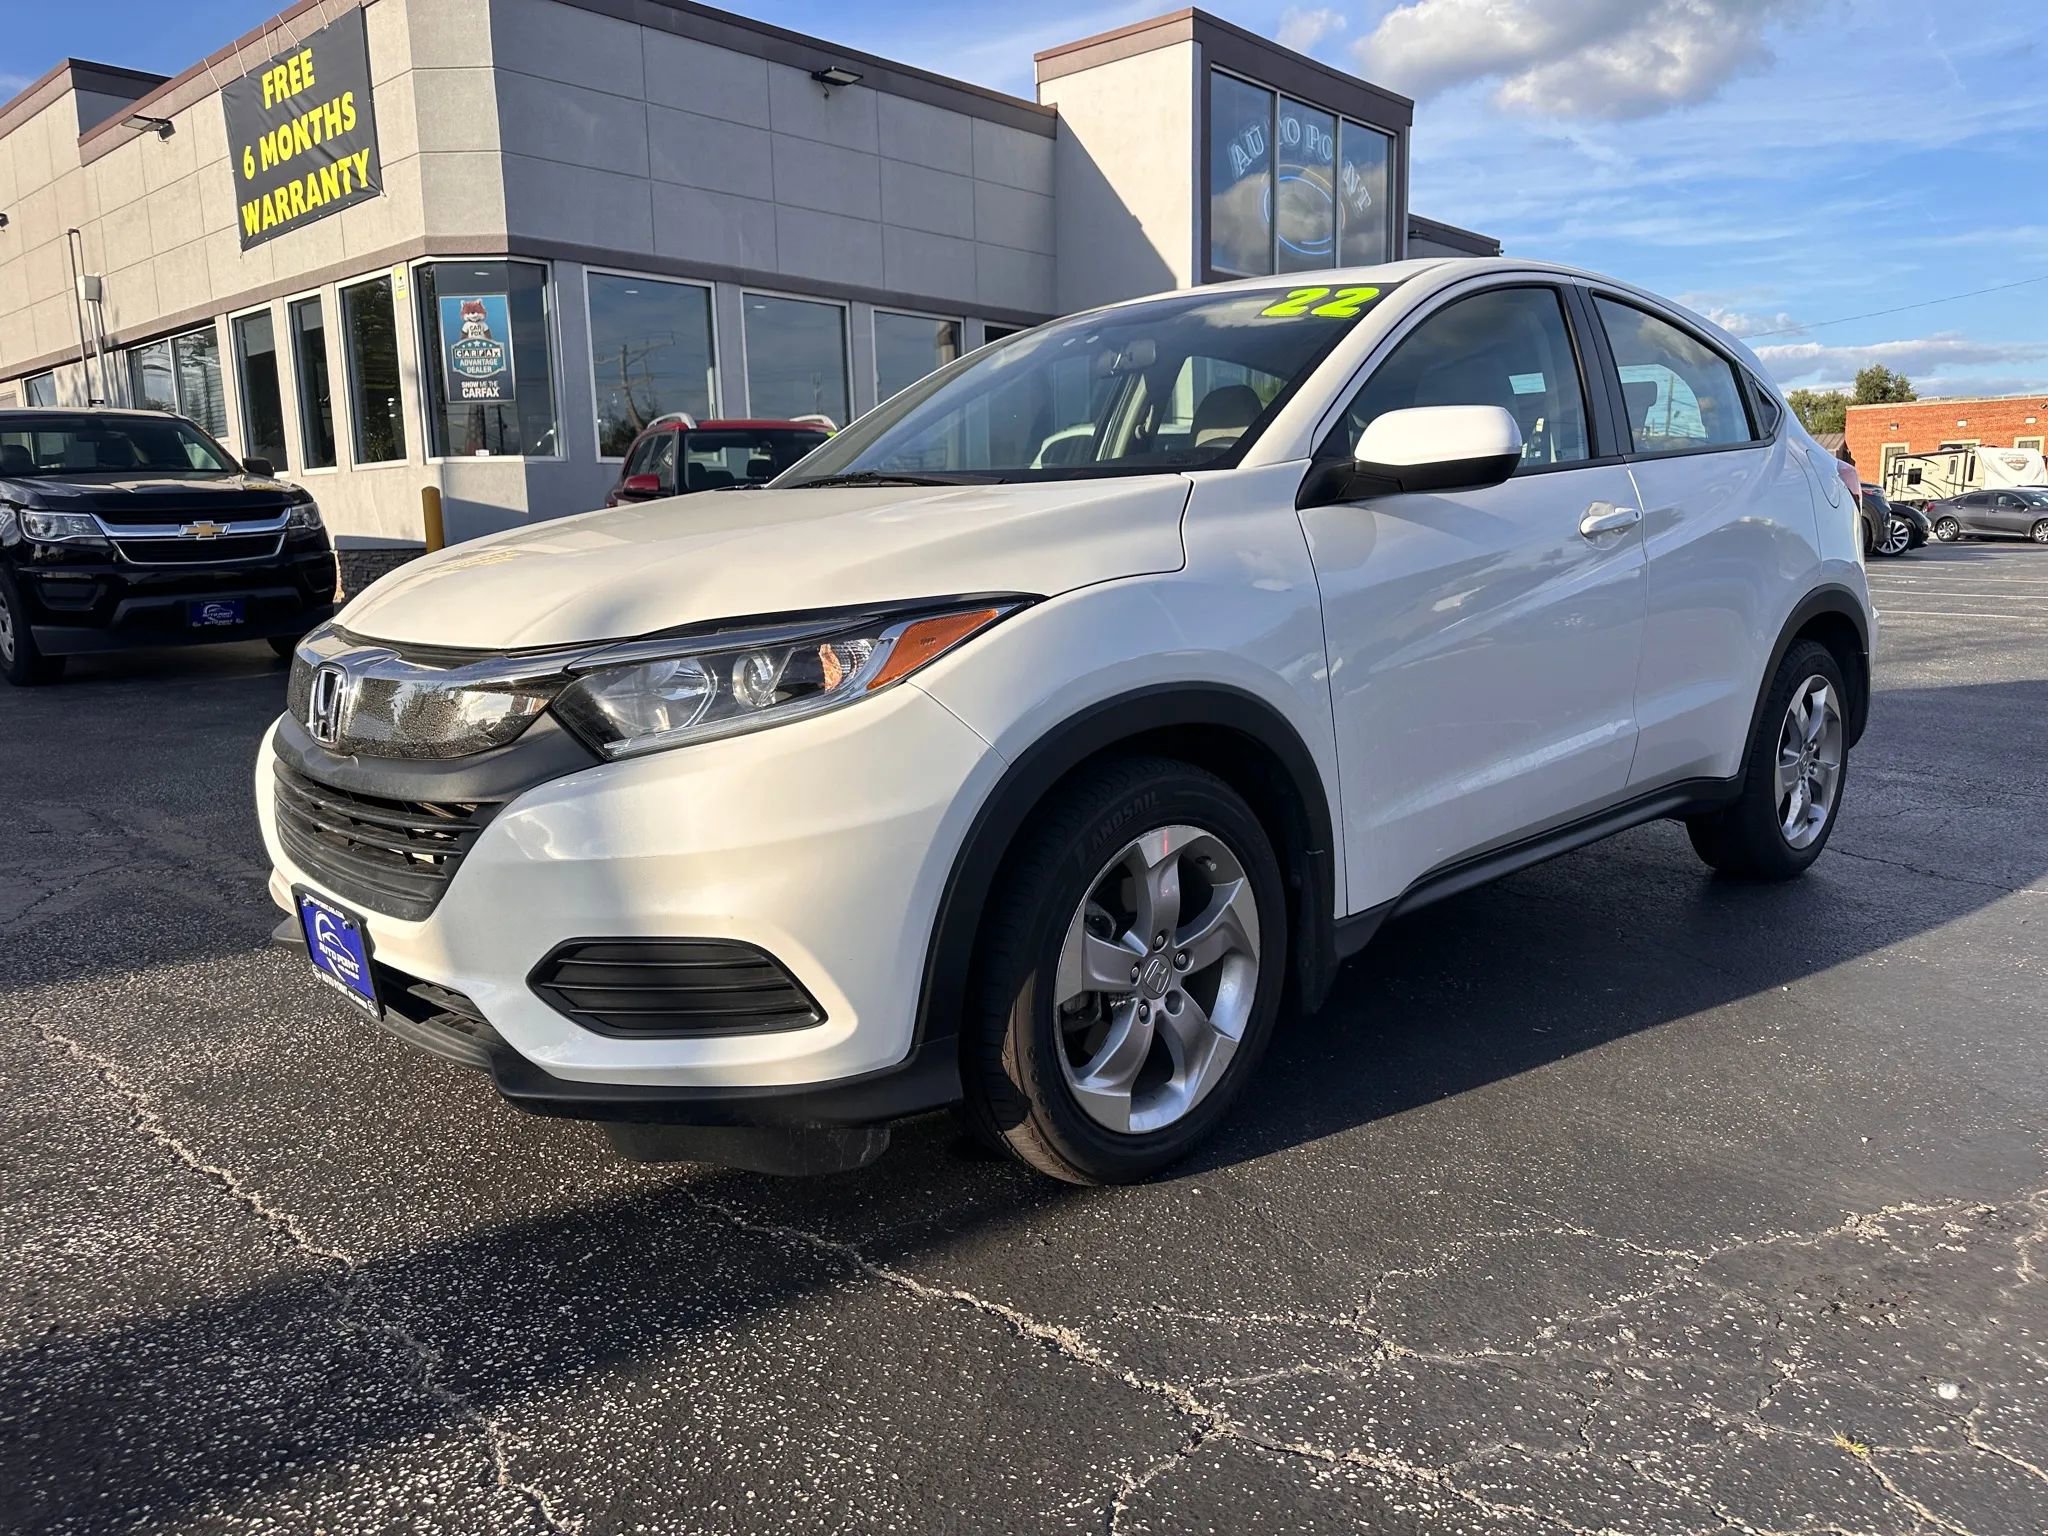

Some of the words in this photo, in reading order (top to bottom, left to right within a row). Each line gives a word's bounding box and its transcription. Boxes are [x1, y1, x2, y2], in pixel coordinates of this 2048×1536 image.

[261, 47, 316, 110] FREE
[243, 145, 256, 181] 6
[259, 91, 357, 172] MONTHS
[241, 147, 370, 238] WARRANTY
[1261, 287, 1380, 318] 22
[456, 349, 501, 358] CARFAX
[460, 358, 498, 367] ADVANTAGE
[466, 366, 493, 374] DEALER
[461, 381, 479, 389] SHOW
[462, 387, 500, 399] CARFAX
